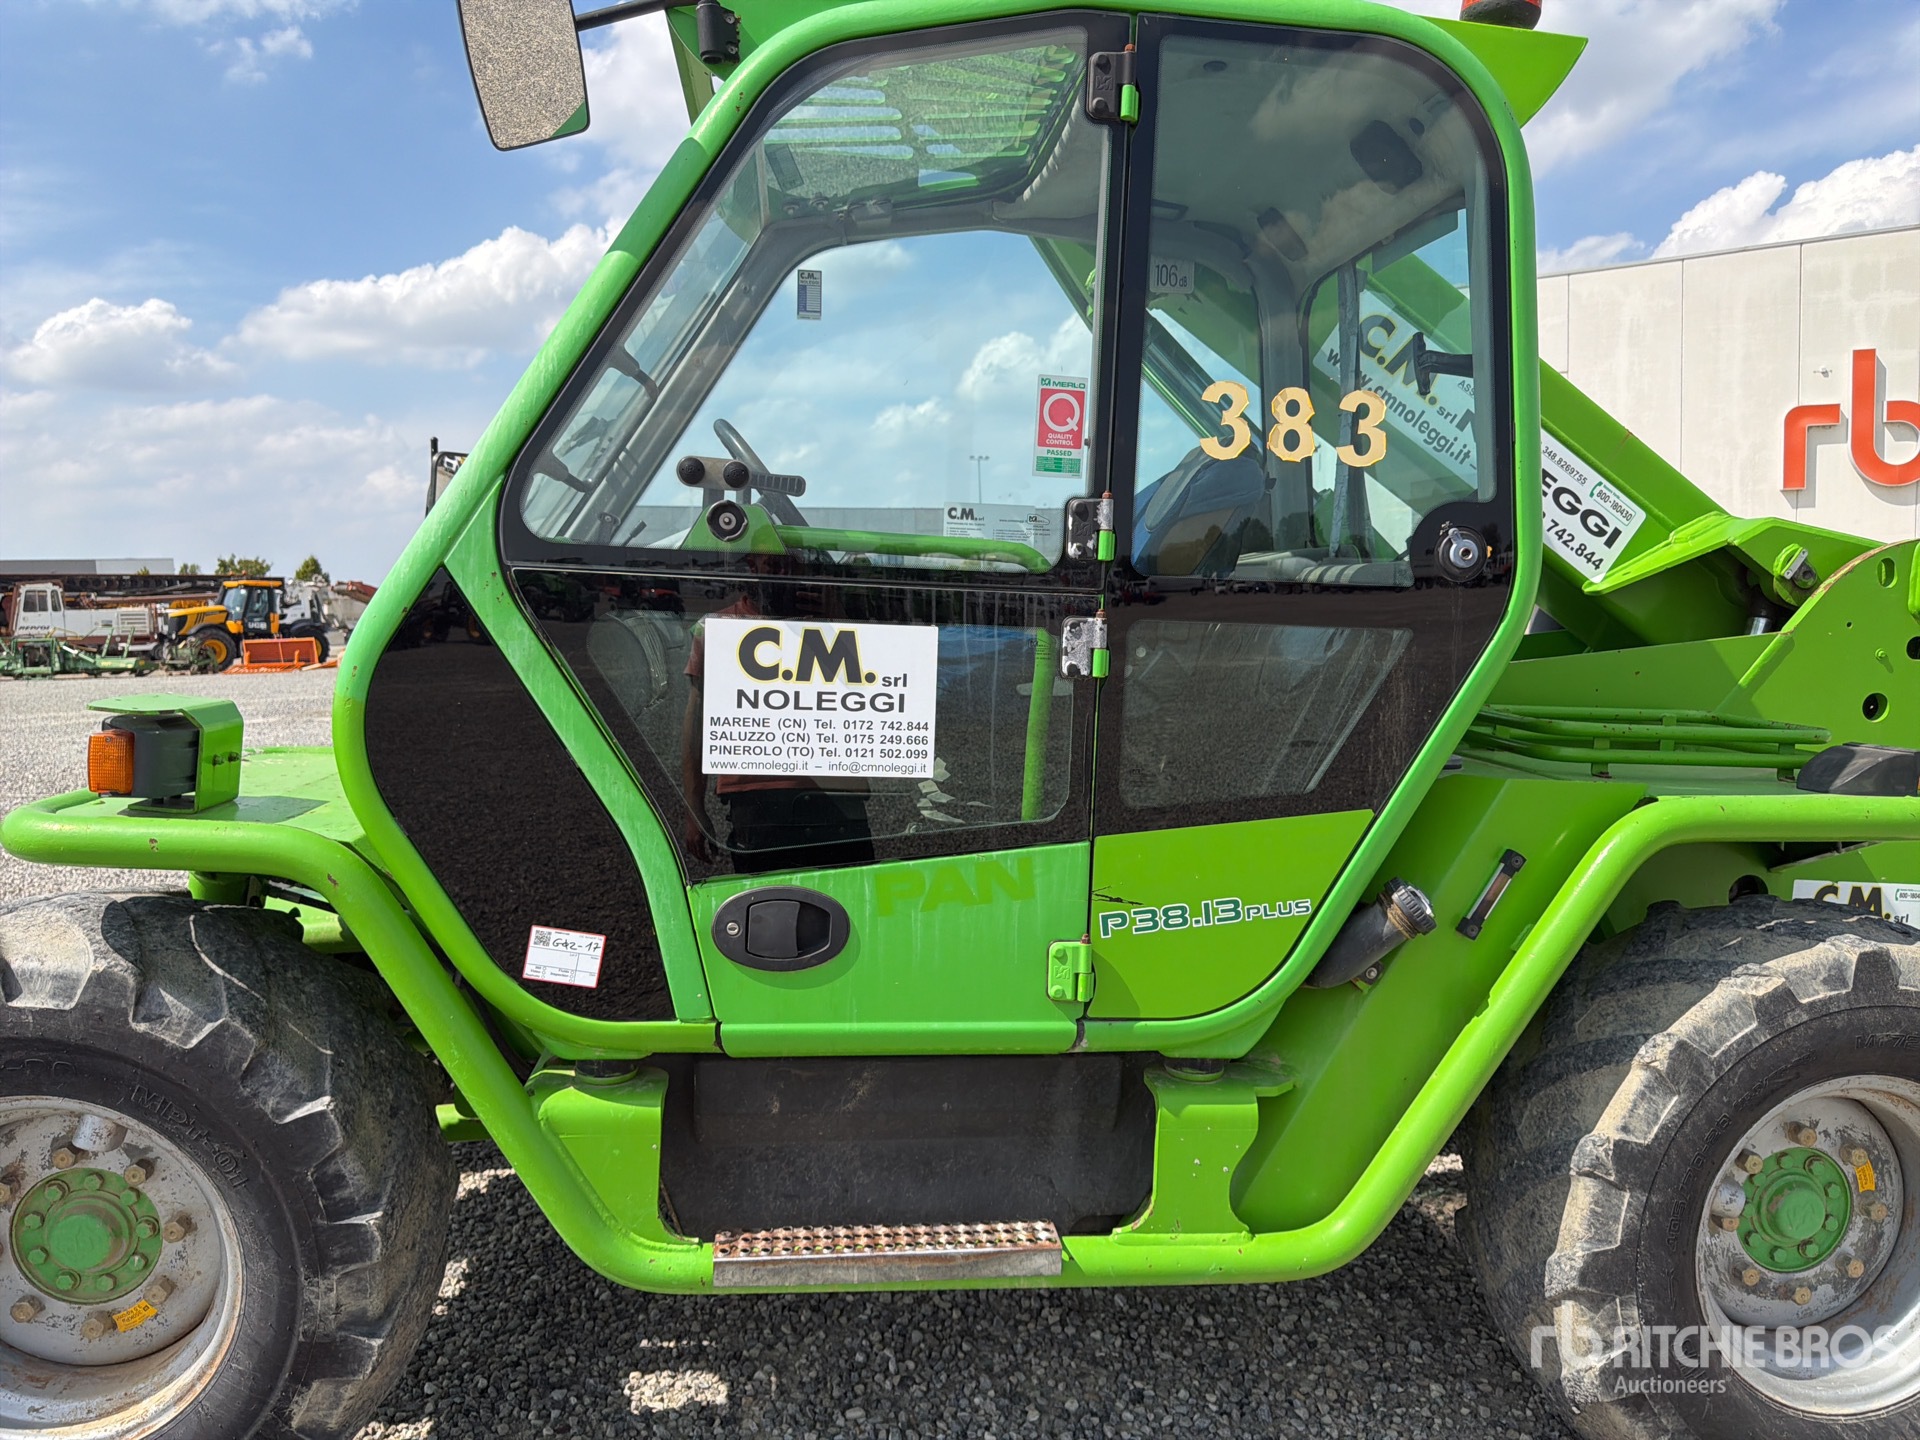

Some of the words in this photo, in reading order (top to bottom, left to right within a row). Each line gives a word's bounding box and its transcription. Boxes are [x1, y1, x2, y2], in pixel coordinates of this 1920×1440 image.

[1052, 381, 1085, 389] MERLO
[1436, 406, 1459, 424] srl
[1783, 348, 1920, 490] rb
[1046, 438, 1074, 446] CONTROL
[1596, 489, 1633, 522] 800-180430
[947, 507, 978, 521] C.M.
[1546, 519, 1604, 570] 742.844
[737, 624, 878, 685] C.M.
[881, 673, 908, 688] srl
[736, 689, 906, 713] NOLEGGI
[709, 716, 771, 728] MARENE
[777, 718, 807, 730] (CN)
[814, 719, 836, 730] Tel.
[843, 720, 874, 731] 0172
[880, 720, 929, 731] 742.844
[709, 730, 776, 742] SALUZZO
[781, 732, 811, 745] (CN)
[816, 733, 838, 744] Tel.
[844, 734, 875, 745] 0175
[880, 734, 929, 745] 249.666
[709, 745, 783, 757] PINEROLO
[786, 746, 815, 759] (TO)
[819, 747, 841, 758] Tel.
[845, 747, 874, 758] 0121
[879, 748, 928, 759] 502.099
[710, 761, 809, 773] www.cmnoleggi.it
[828, 762, 928, 775] info@cmnoleggi.it
[875, 857, 1035, 917] PAN
